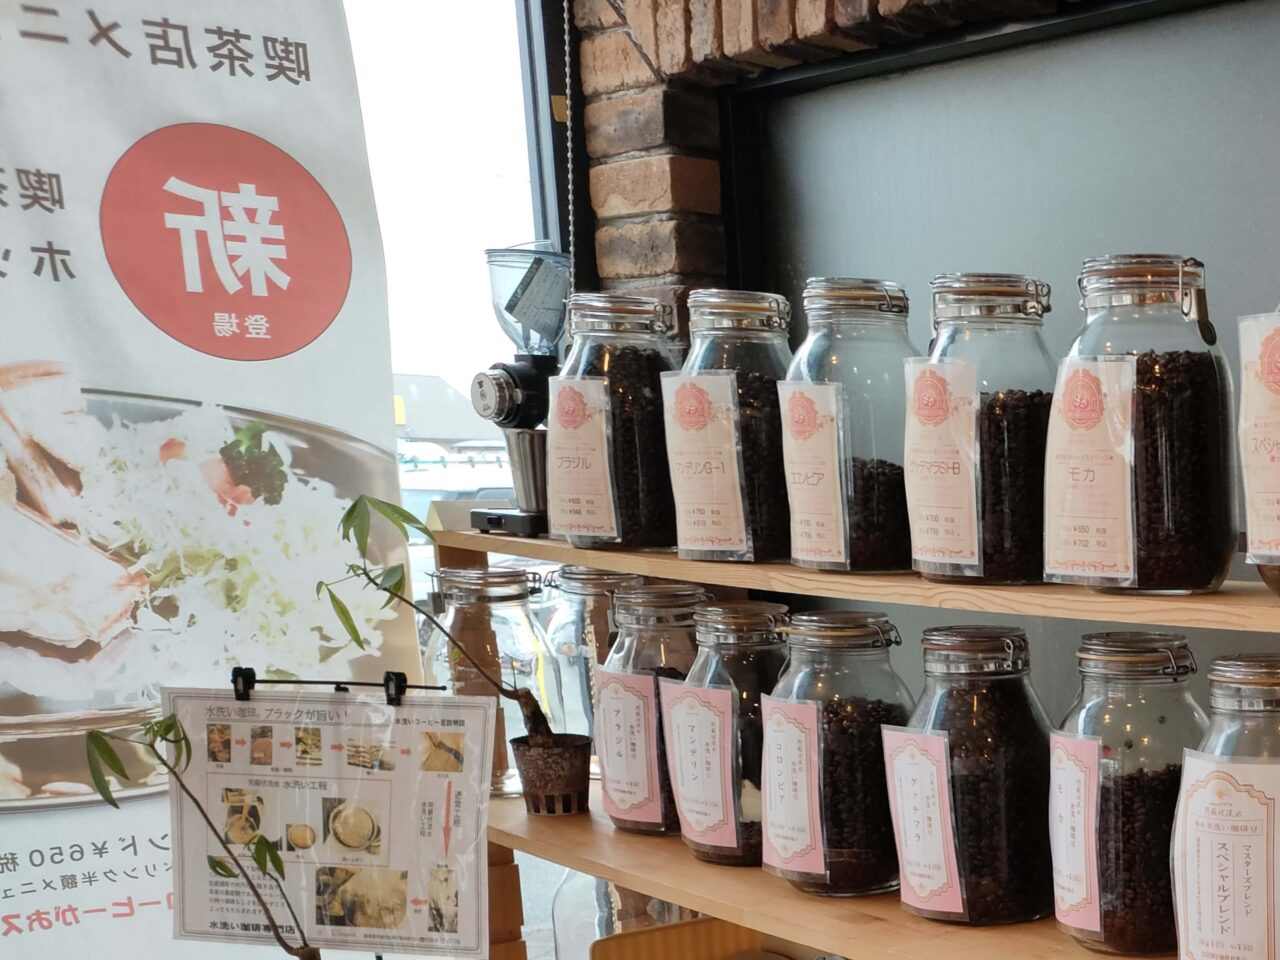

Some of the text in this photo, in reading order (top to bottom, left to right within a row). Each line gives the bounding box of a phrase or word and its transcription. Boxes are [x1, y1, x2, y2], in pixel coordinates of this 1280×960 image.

[1068, 466, 1097, 483] モカ
[1216, 841, 1232, 935] スペシャルブレンド
